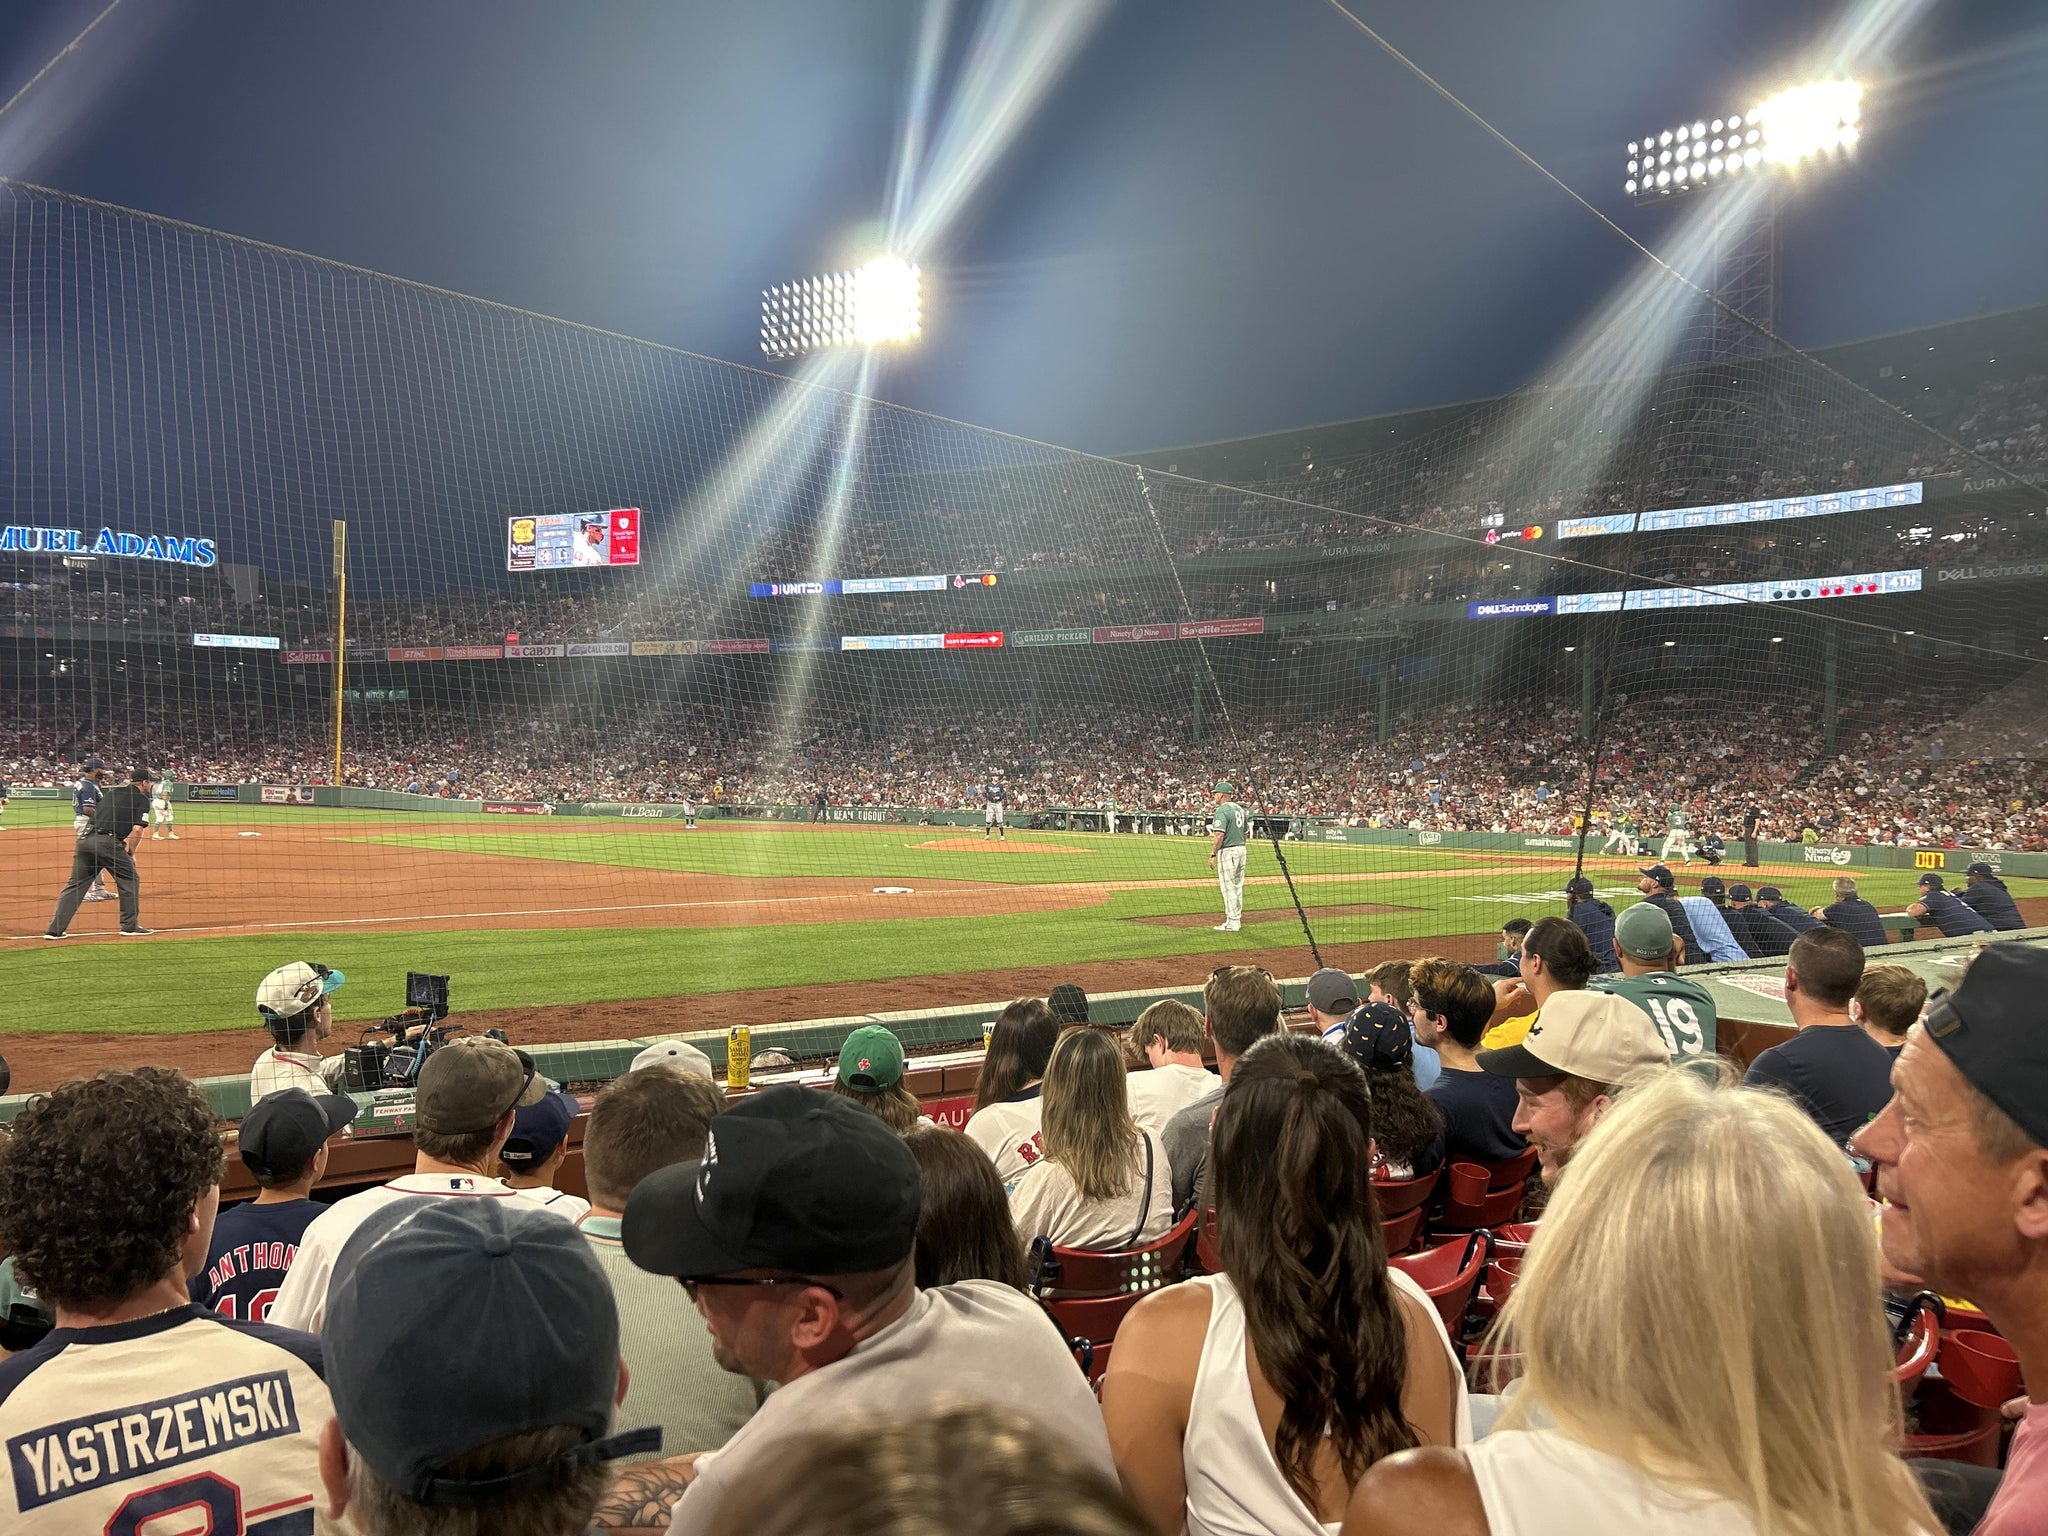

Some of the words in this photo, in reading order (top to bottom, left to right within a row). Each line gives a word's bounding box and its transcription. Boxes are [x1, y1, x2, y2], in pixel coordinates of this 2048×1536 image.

[91, 526, 216, 568] ADAMS
[1351, 543, 1390, 554] PAVILION
[1856, 574, 1875, 583] OUT
[1938, 568, 1978, 581] DELL
[1818, 576, 1847, 587] STRIKE
[1889, 575, 1916, 587] 4TH
[782, 582, 823, 595] UNITED
[1478, 603, 1501, 615] DELL
[1499, 602, 1549, 614] Technologies
[1024, 633, 1054, 642] GRILLO'S
[1057, 632, 1088, 640] PICKLES
[1110, 629, 1132, 638] Ninety
[1144, 628, 1160, 636] Nine
[304, 652, 325, 661] PIZZA
[404, 650, 426, 658] STIHL
[467, 646, 500, 657] Hawaiian
[621, 806, 663, 818] L.L.Bean
[1674, 815, 1682, 825] 3
[1524, 837, 1573, 848] smartwater
[1804, 846, 1832, 856] Ninety
[1804, 853, 1831, 863] Nine
[1914, 851, 1945, 869] 007
[1647, 997, 1704, 1055] 19
[375, 1106, 402, 1115] FENWAY
[20, 1379, 289, 1497] YASTRZEMSKI
